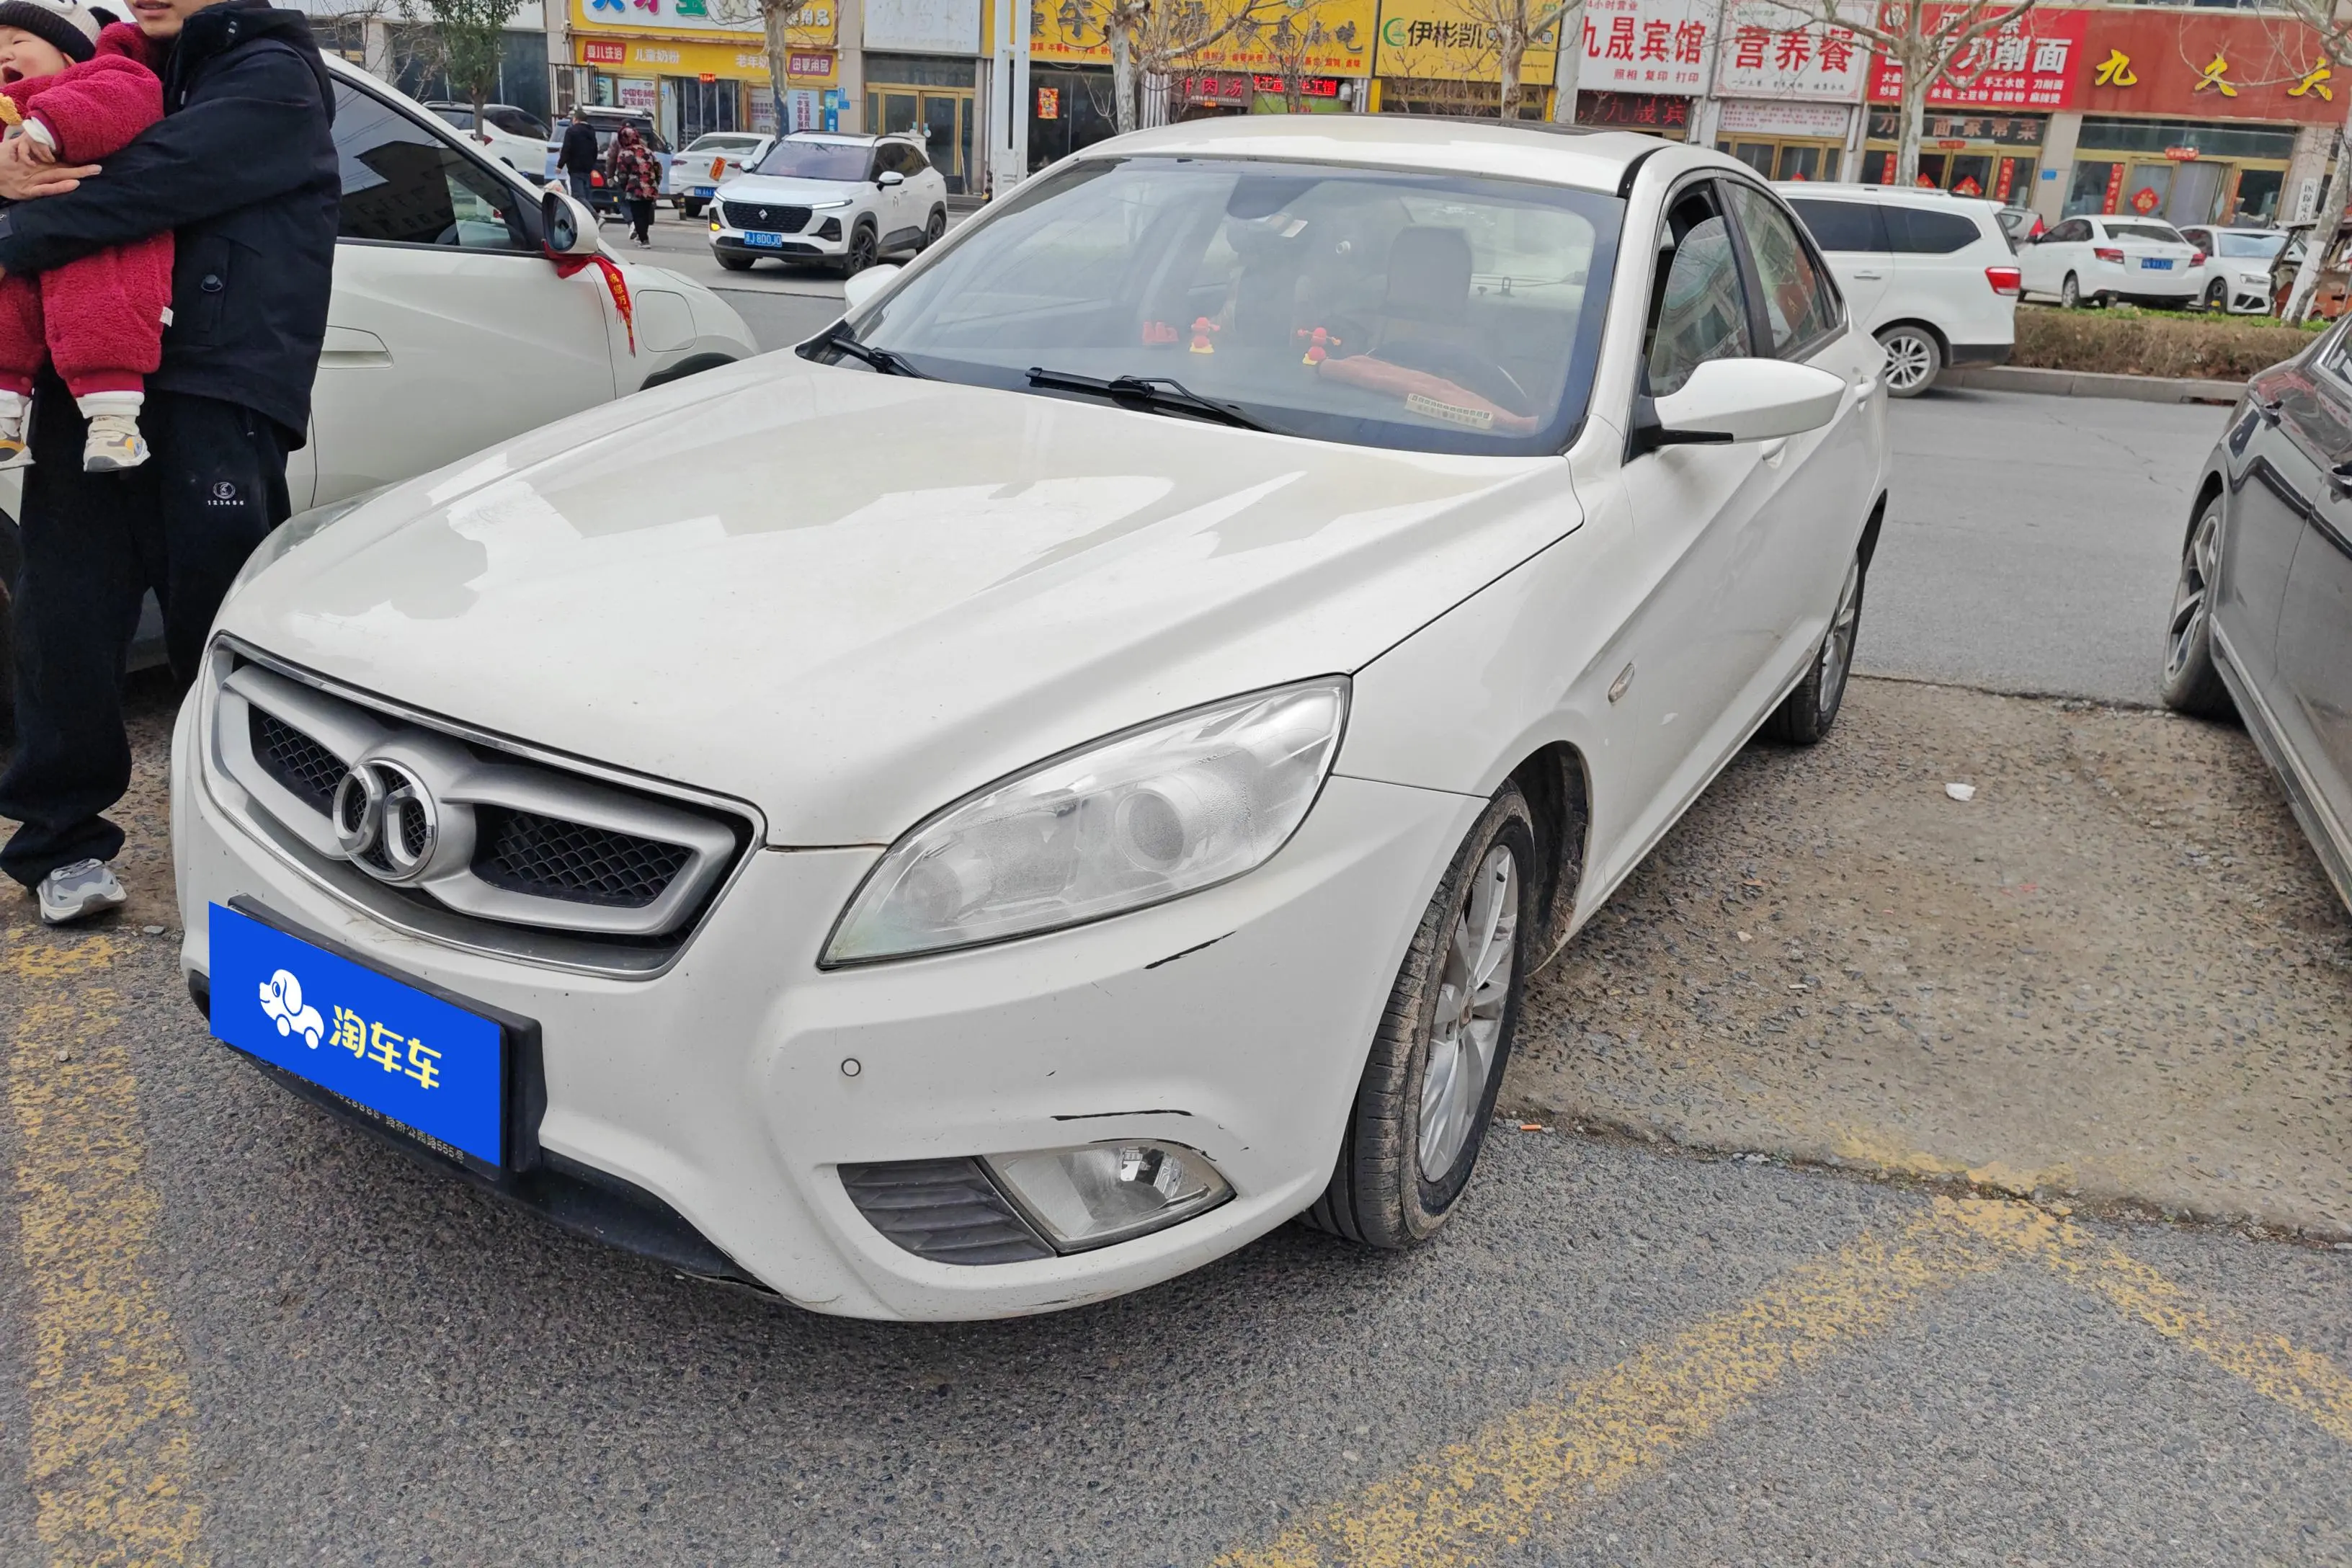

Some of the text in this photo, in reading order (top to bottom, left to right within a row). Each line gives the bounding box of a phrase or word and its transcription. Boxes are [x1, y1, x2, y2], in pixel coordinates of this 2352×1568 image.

[1585, 0, 1639, 11] 4小时营业
[1407, 19, 1483, 49] 伊彬凯
[1582, 15, 1706, 64] 九晟宾馆
[634, 48, 680, 63] 儿童奶粉
[1734, 25, 1855, 74] 营养餐
[1885, 36, 2072, 74] 刀削面
[735, 53, 769, 69] 老年奶
[1675, 71, 1699, 83] 打印
[2033, 79, 2064, 91] 刀削面
[1876, 113, 2039, 141] 刀面家常菜
